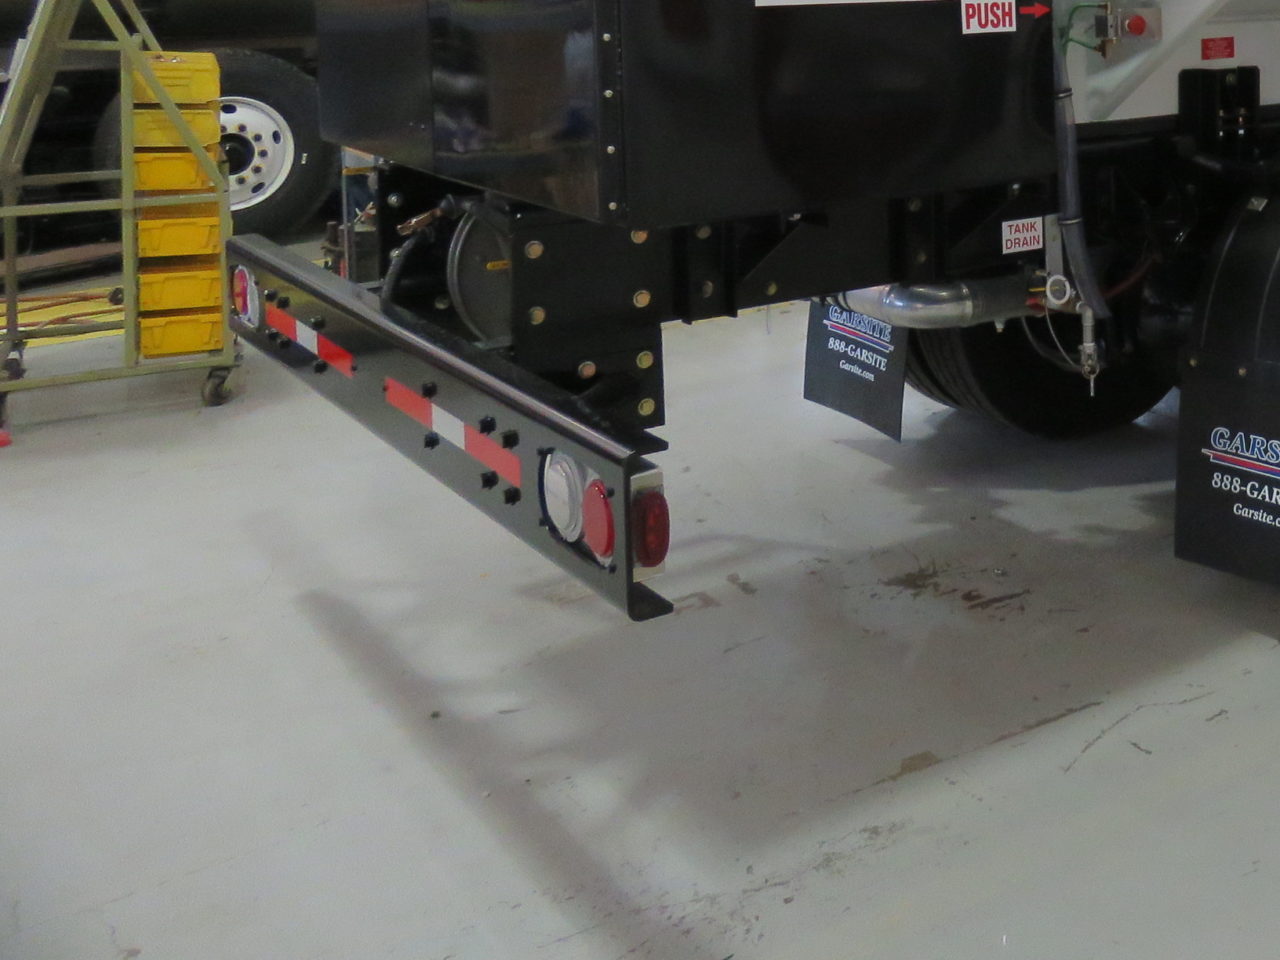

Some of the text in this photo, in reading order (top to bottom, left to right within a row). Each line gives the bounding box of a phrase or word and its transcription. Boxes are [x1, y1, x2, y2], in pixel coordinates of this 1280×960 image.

[964, 1, 1013, 29] PUSH
[1007, 221, 1038, 235] TANK
[1005, 235, 1040, 250] DRAIN
[829, 305, 892, 342] GARSITE
[828, 337, 888, 371] 888-GARSITE
[839, 359, 875, 381] Garsite.com
